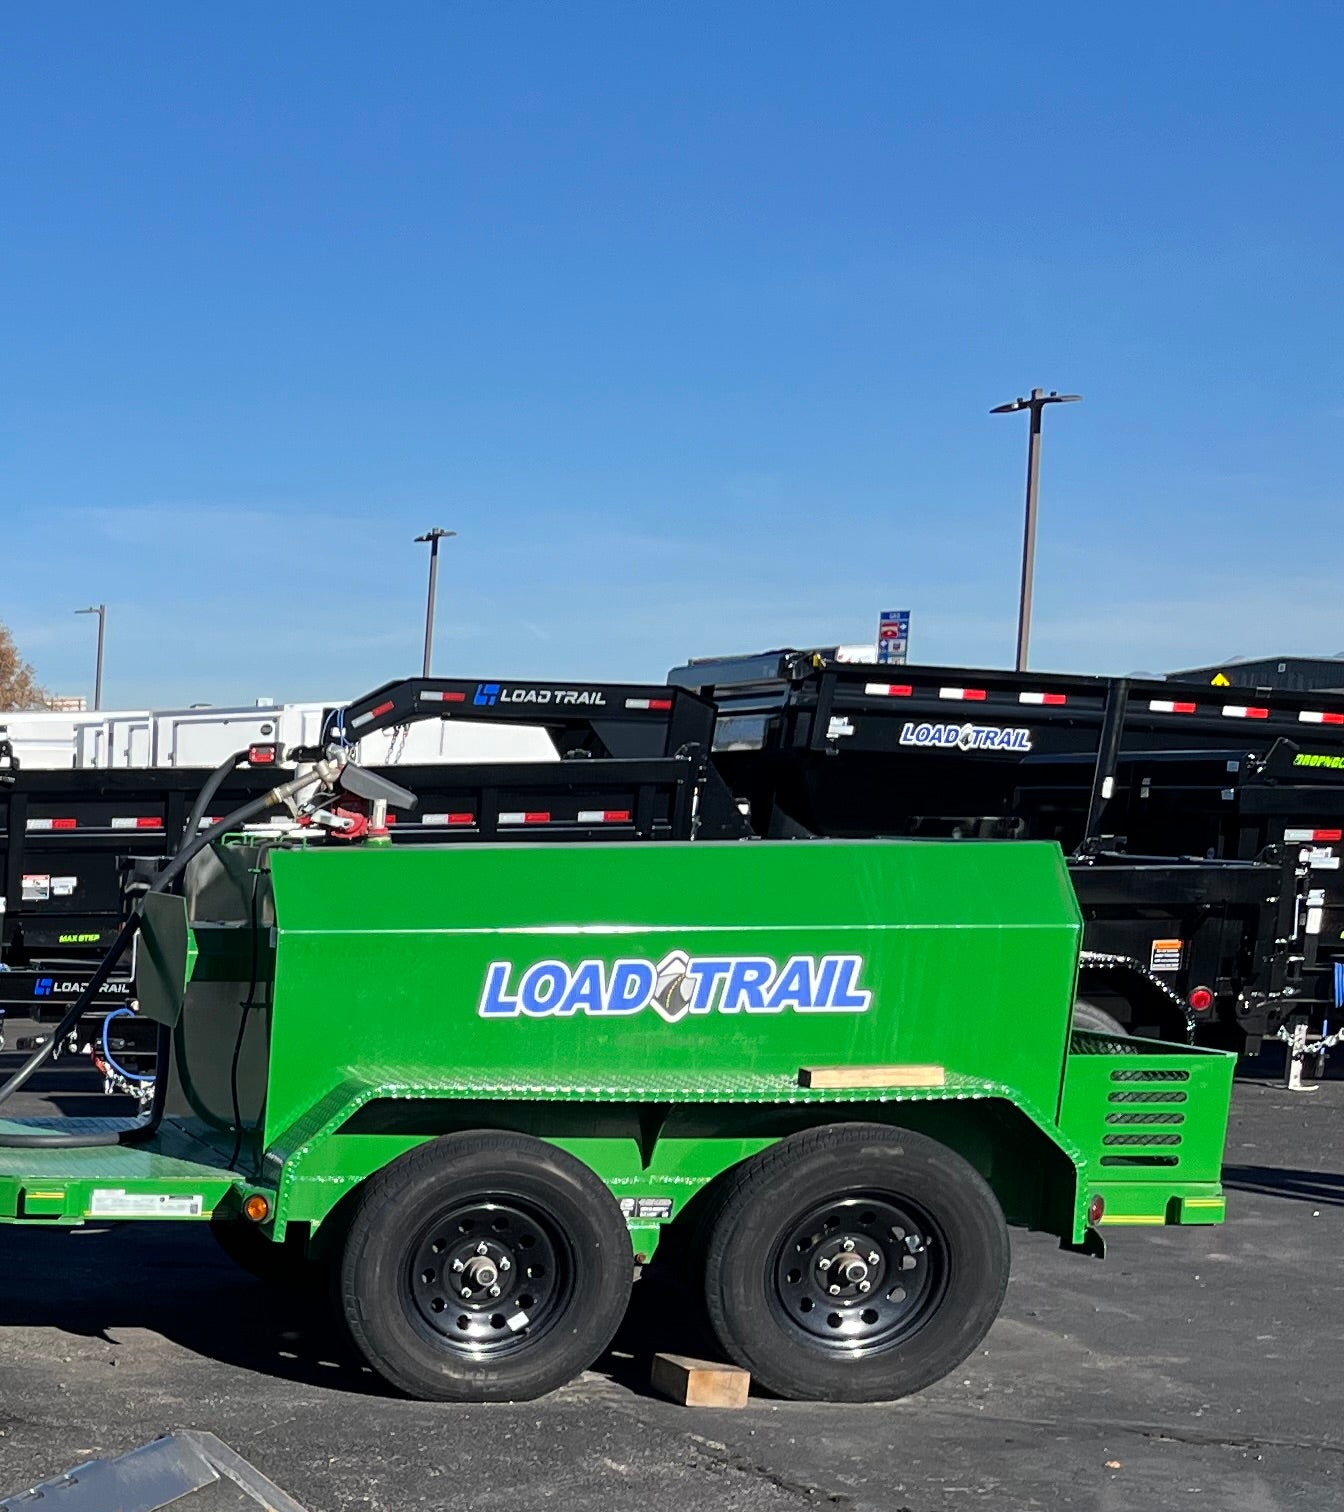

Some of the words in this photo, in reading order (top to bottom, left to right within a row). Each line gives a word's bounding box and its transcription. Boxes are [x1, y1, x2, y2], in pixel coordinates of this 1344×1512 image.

[500, 689, 551, 704] LOAD
[554, 690, 606, 705] TRAIL
[901, 724, 961, 745] LOAD
[971, 728, 1031, 749] TRAIL
[59, 934, 77, 943] MAX
[78, 934, 100, 942] STEP
[98, 982, 130, 993] RAIL
[481, 961, 656, 1015] LOAD
[687, 956, 869, 1011] TRAIL
